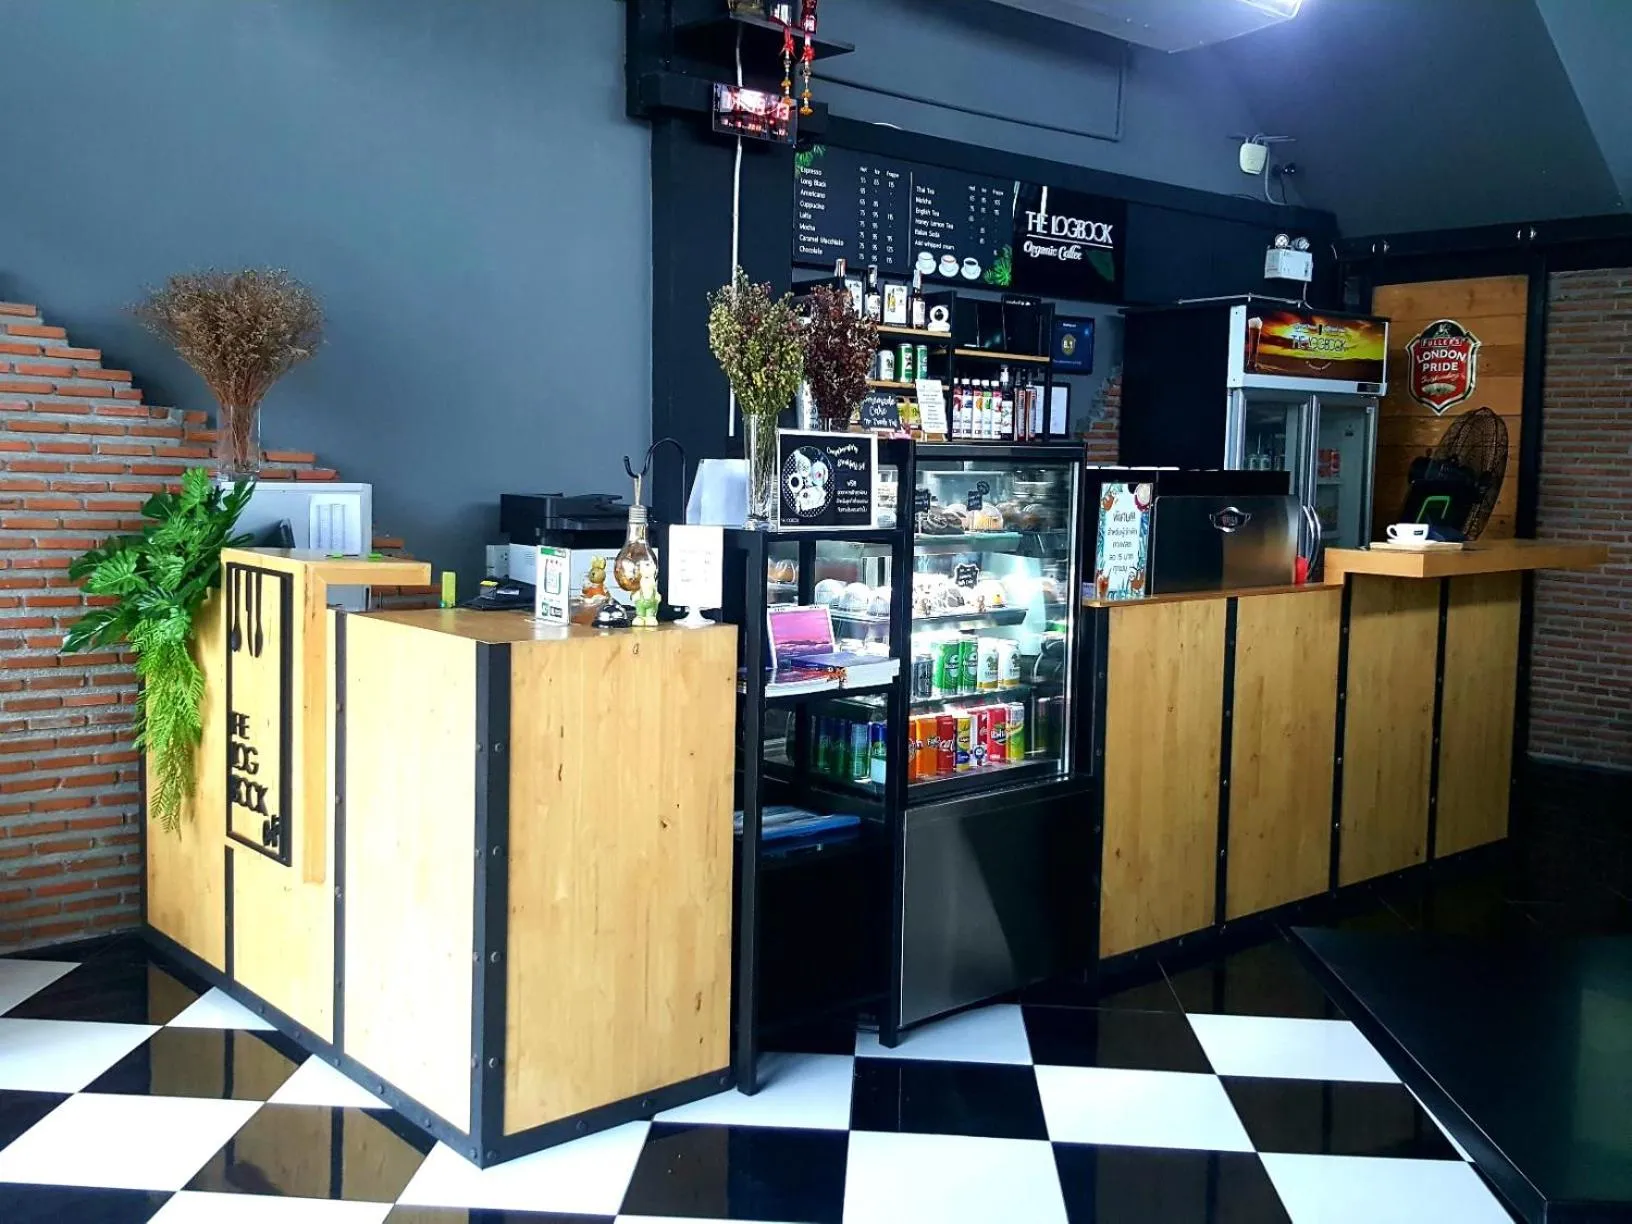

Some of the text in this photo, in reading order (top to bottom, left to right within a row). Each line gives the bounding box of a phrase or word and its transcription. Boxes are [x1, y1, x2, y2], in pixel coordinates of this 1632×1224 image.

[800, 178, 813, 187] Long
[1025, 210, 1113, 244] THE LOGBOOK
[1023, 240, 1083, 261] Organic Coffee
[1416, 349, 1467, 365] LONDON
[1422, 362, 1459, 373] PRIDE
